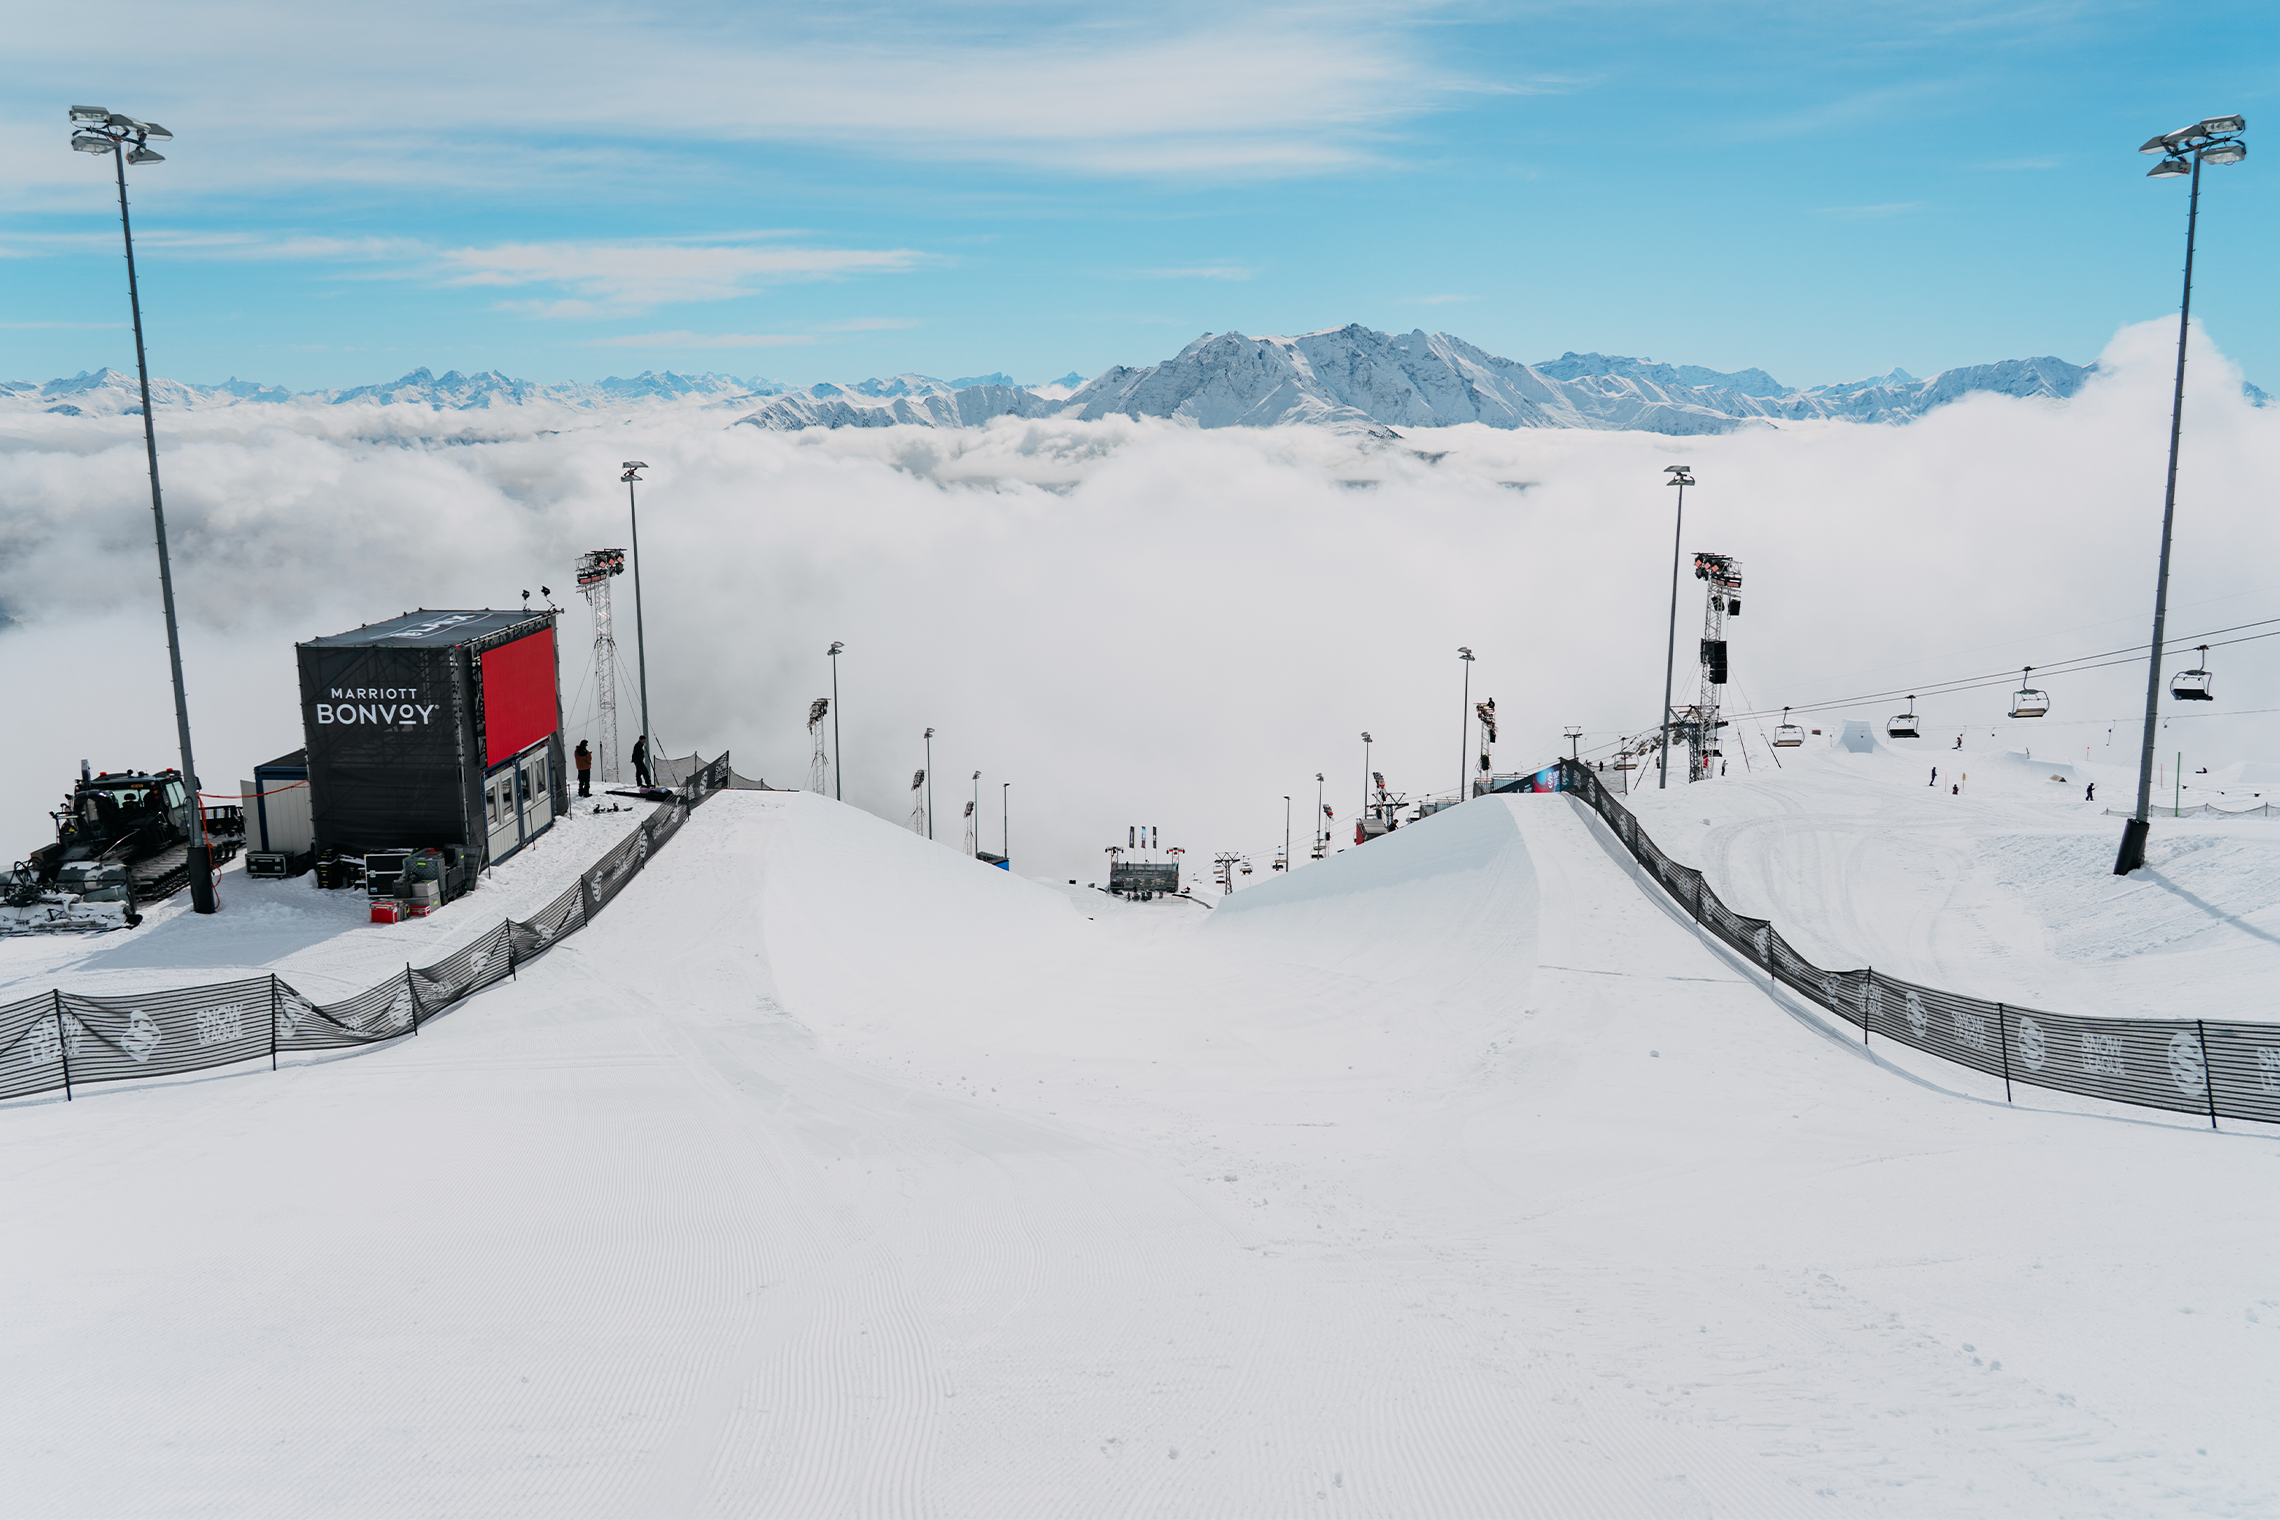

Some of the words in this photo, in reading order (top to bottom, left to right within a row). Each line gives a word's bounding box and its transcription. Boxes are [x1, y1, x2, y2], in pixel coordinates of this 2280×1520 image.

[331, 688, 417, 700] MARRIOTT
[316, 703, 434, 725] BONVOY
[197, 1003, 243, 1029] SNOW
[197, 1024, 243, 1045] LEAGUE
[2081, 1032, 2122, 1057] SNOW
[2082, 1052, 2125, 1075] LEAGUE
